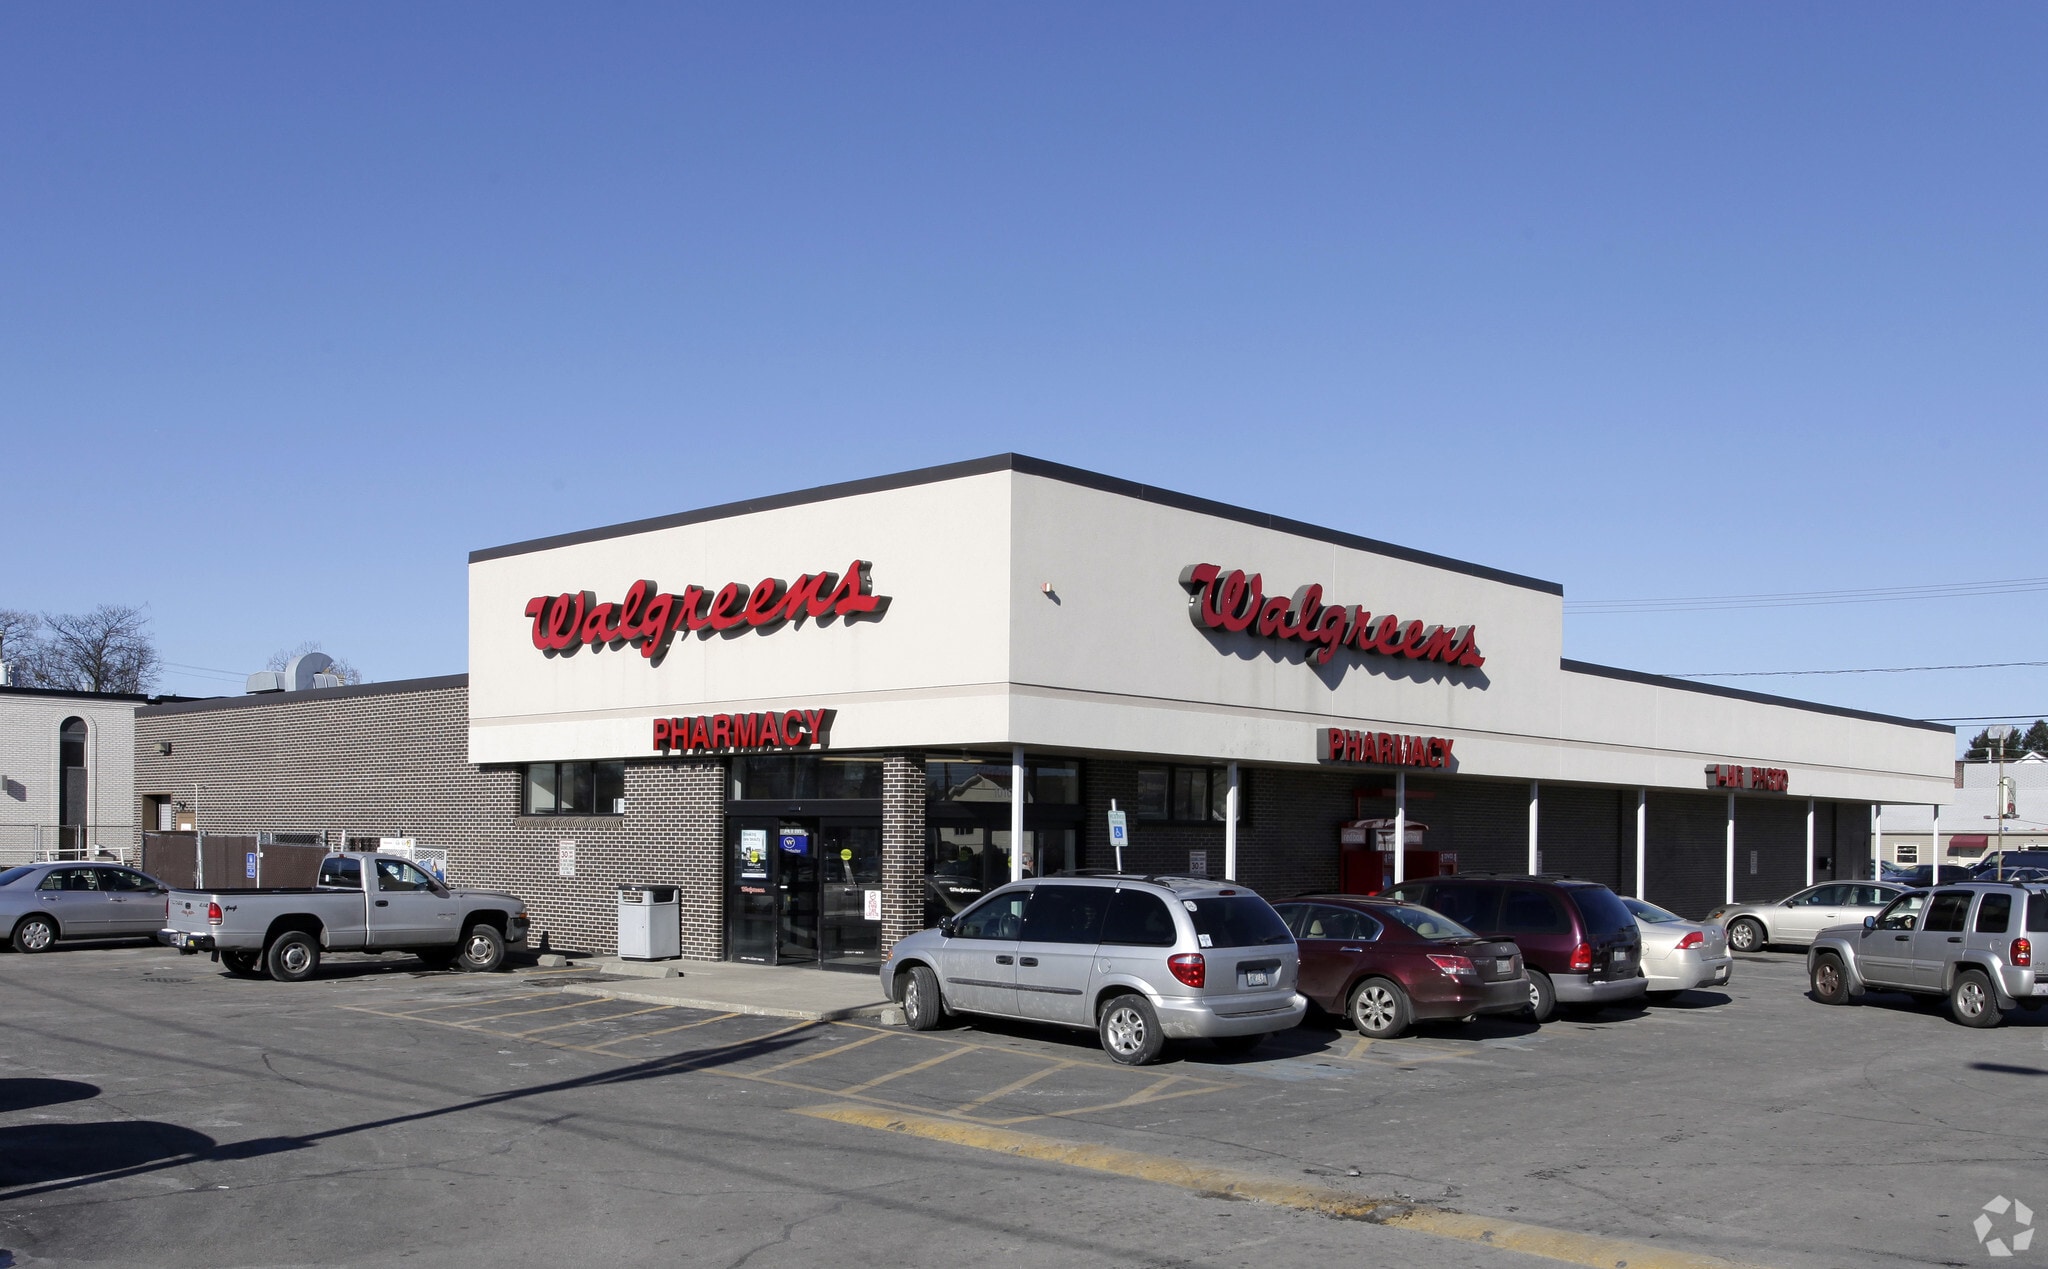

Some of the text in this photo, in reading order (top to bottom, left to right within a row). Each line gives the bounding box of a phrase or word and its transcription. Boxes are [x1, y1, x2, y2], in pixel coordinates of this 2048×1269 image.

[525, 559, 882, 659] Walgreens
[1188, 562, 1486, 667] Walgreens
[653, 708, 826, 751] PHARMACY
[1328, 727, 1455, 768] PHARMACY
[1751, 766, 1789, 791] PHOTO
